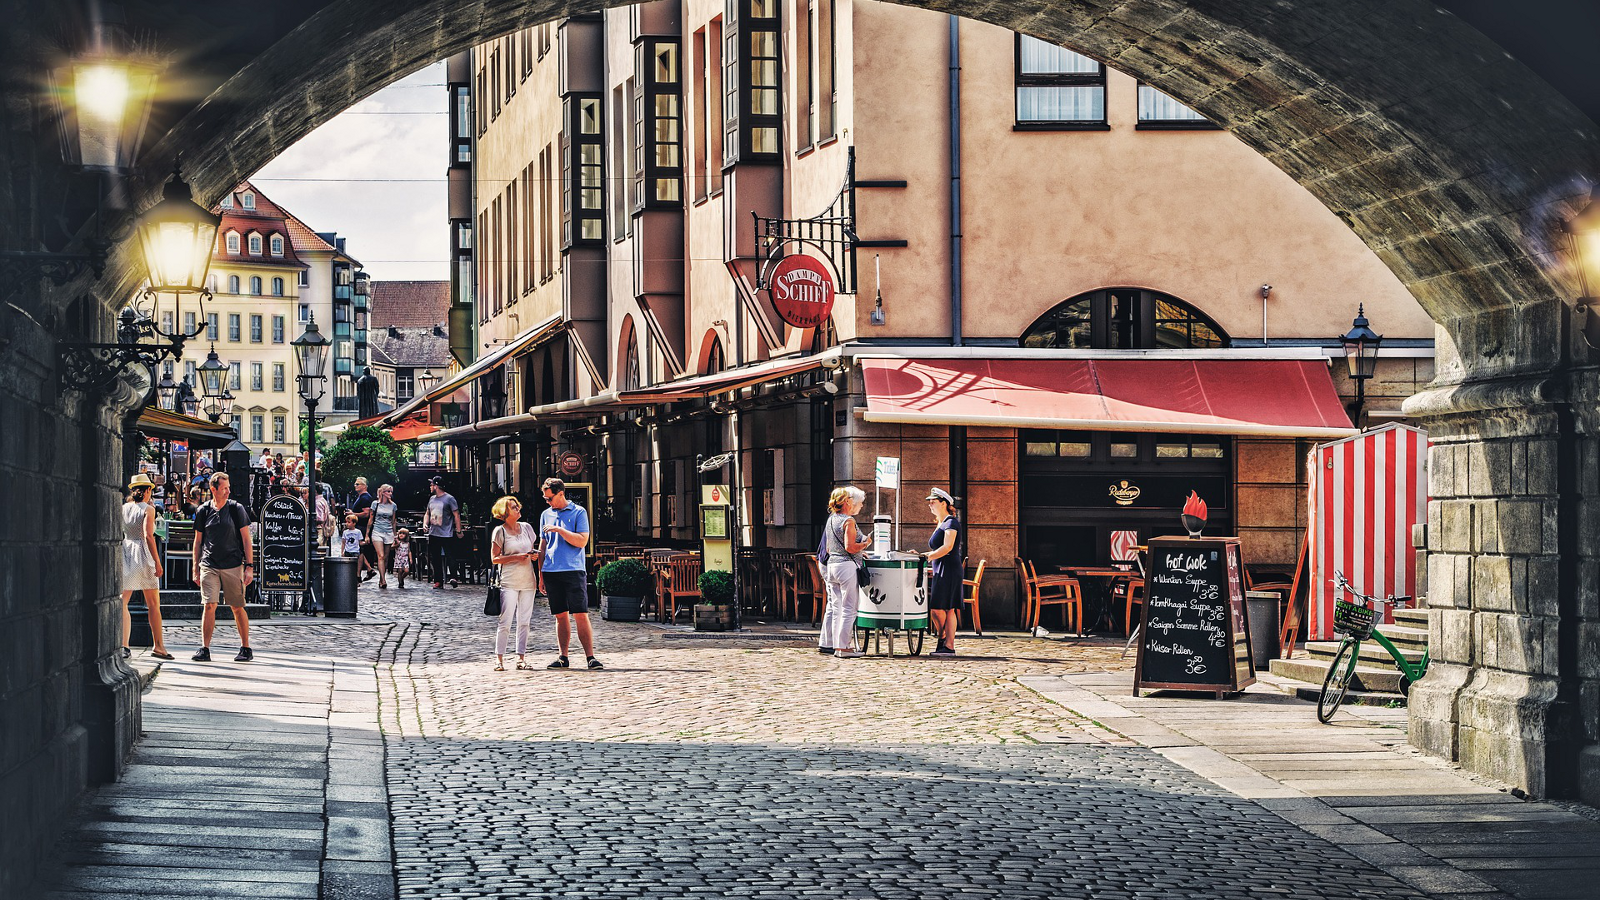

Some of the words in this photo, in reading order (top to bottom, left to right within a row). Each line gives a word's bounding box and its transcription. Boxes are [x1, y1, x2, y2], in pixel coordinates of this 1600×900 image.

[788, 270, 821, 284] DAMPF
[776, 275, 832, 304] SCHIFF
[1185, 574, 1208, 592] Suppe
[1190, 598, 1211, 617] Suppe
[1357, 607, 1373, 616] BIKE
